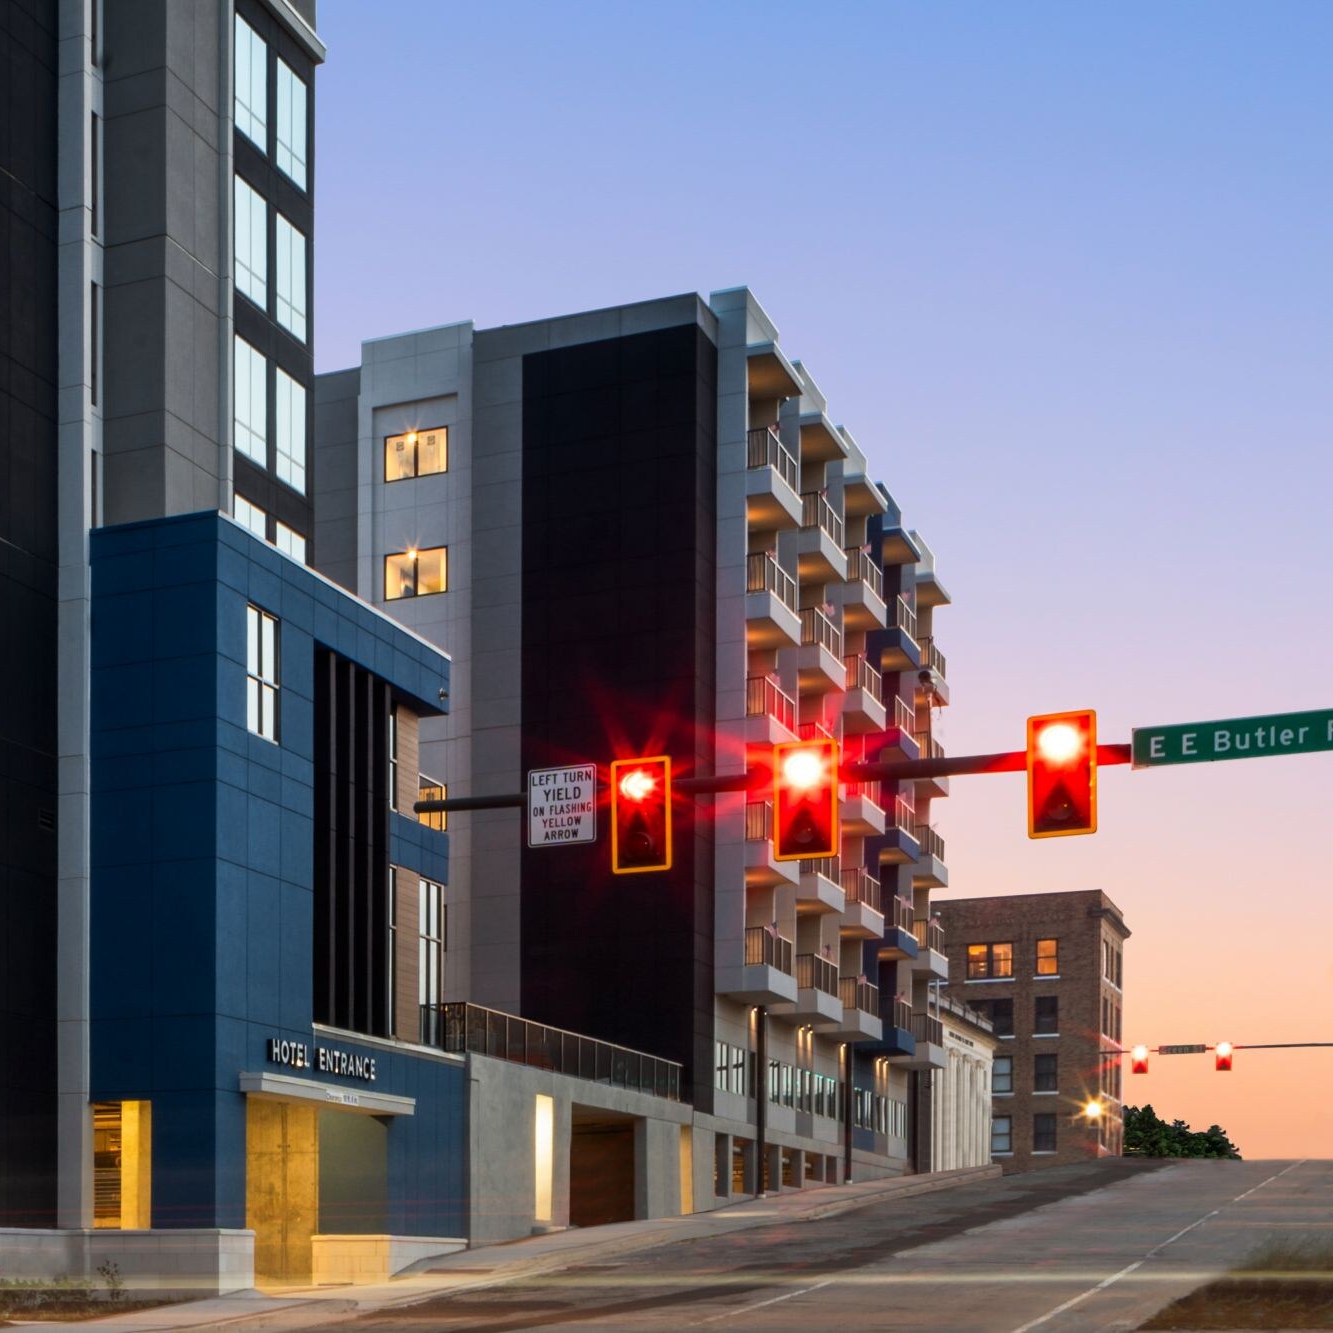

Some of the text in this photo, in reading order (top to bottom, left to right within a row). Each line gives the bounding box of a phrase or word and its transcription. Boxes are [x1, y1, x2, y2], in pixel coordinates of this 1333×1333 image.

[1149, 735, 1166, 758] E
[1181, 732, 1198, 755] E
[1213, 725, 1310, 753] Butler
[532, 769, 592, 787] LEFT TURN
[543, 786, 581, 802] YIELD
[533, 801, 592, 817] ON FLASHING
[542, 816, 582, 828] YELLOW
[544, 828, 579, 841] ARROW
[272, 1038, 376, 1080] HOTEL ENTRANCE
